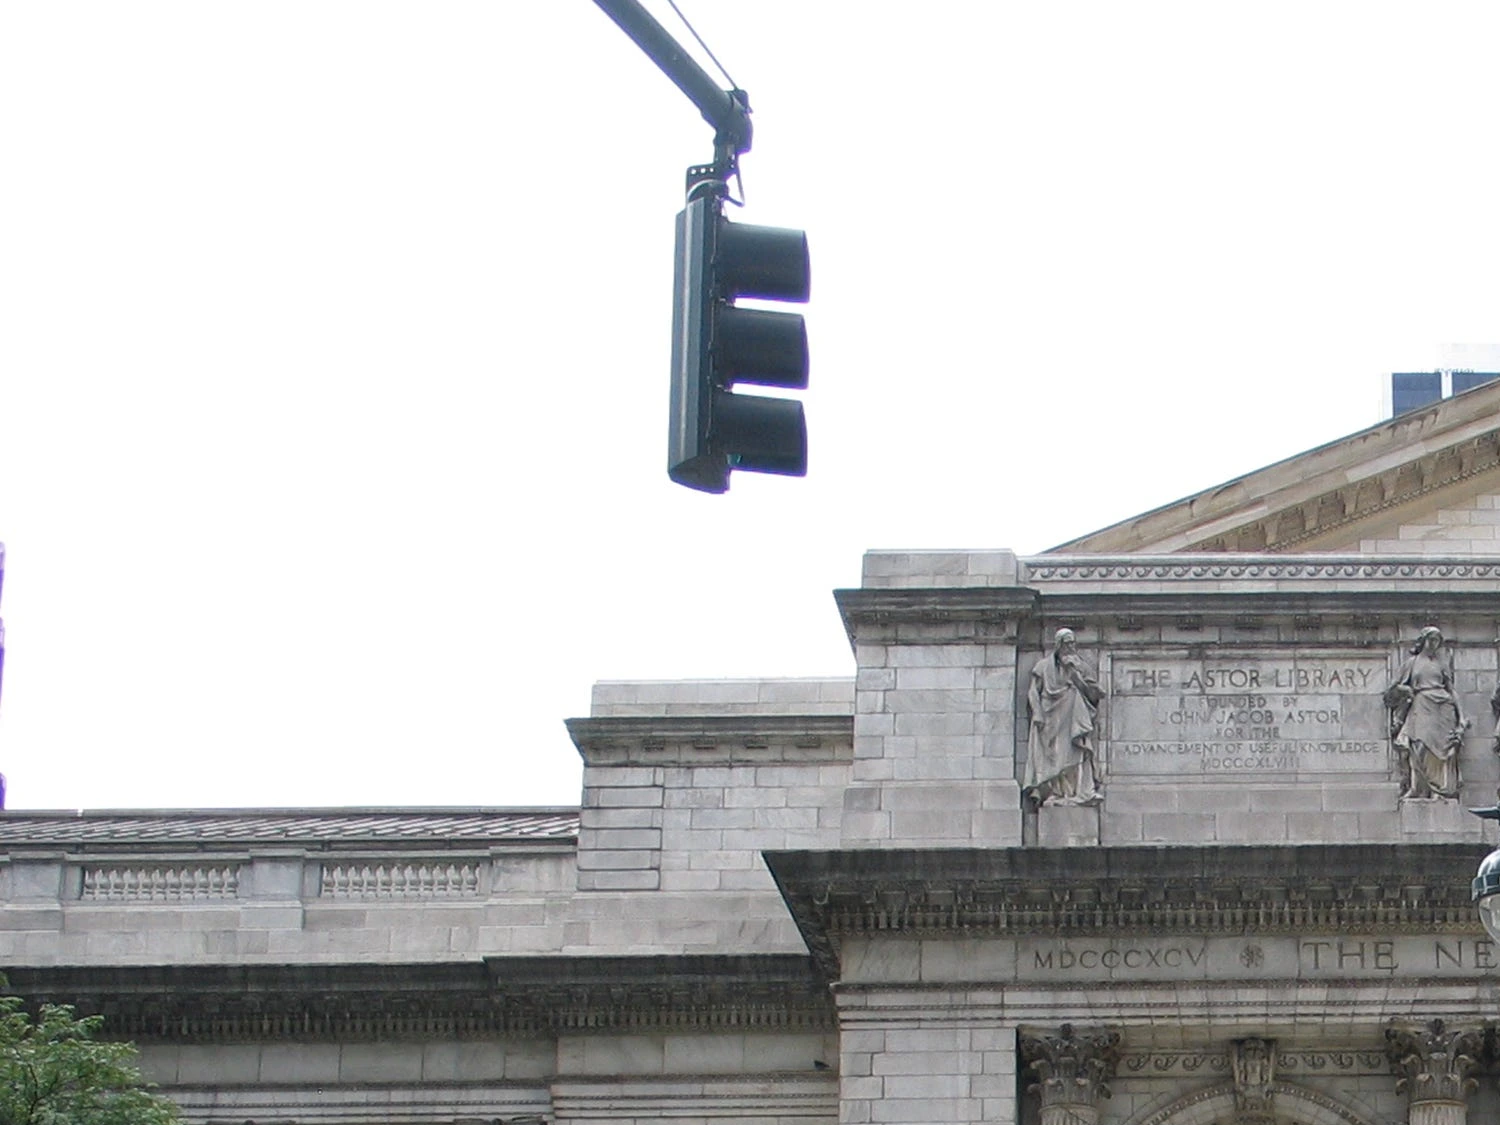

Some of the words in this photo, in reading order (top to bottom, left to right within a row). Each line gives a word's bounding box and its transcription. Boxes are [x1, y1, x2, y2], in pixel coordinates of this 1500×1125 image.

[1128, 669, 1171, 688] THE
[1184, 669, 1260, 688] ASTOR
[1274, 668, 1373, 688] LIBRARY
[1200, 696, 1266, 708] FOUNDED
[1282, 696, 1299, 707] BY
[1160, 710, 1206, 725] JOHN
[1216, 710, 1274, 725] JACOB
[1284, 710, 1341, 724] ASTOR
[1215, 726, 1244, 739] FOR
[1251, 726, 1280, 739] THE
[1123, 742, 1222, 756] ADVANCEMENT
[1301, 741, 1379, 753] KNOWLEDGE
[1033, 948, 1206, 970] MDCCCXCV
[1303, 940, 1399, 971] THE
